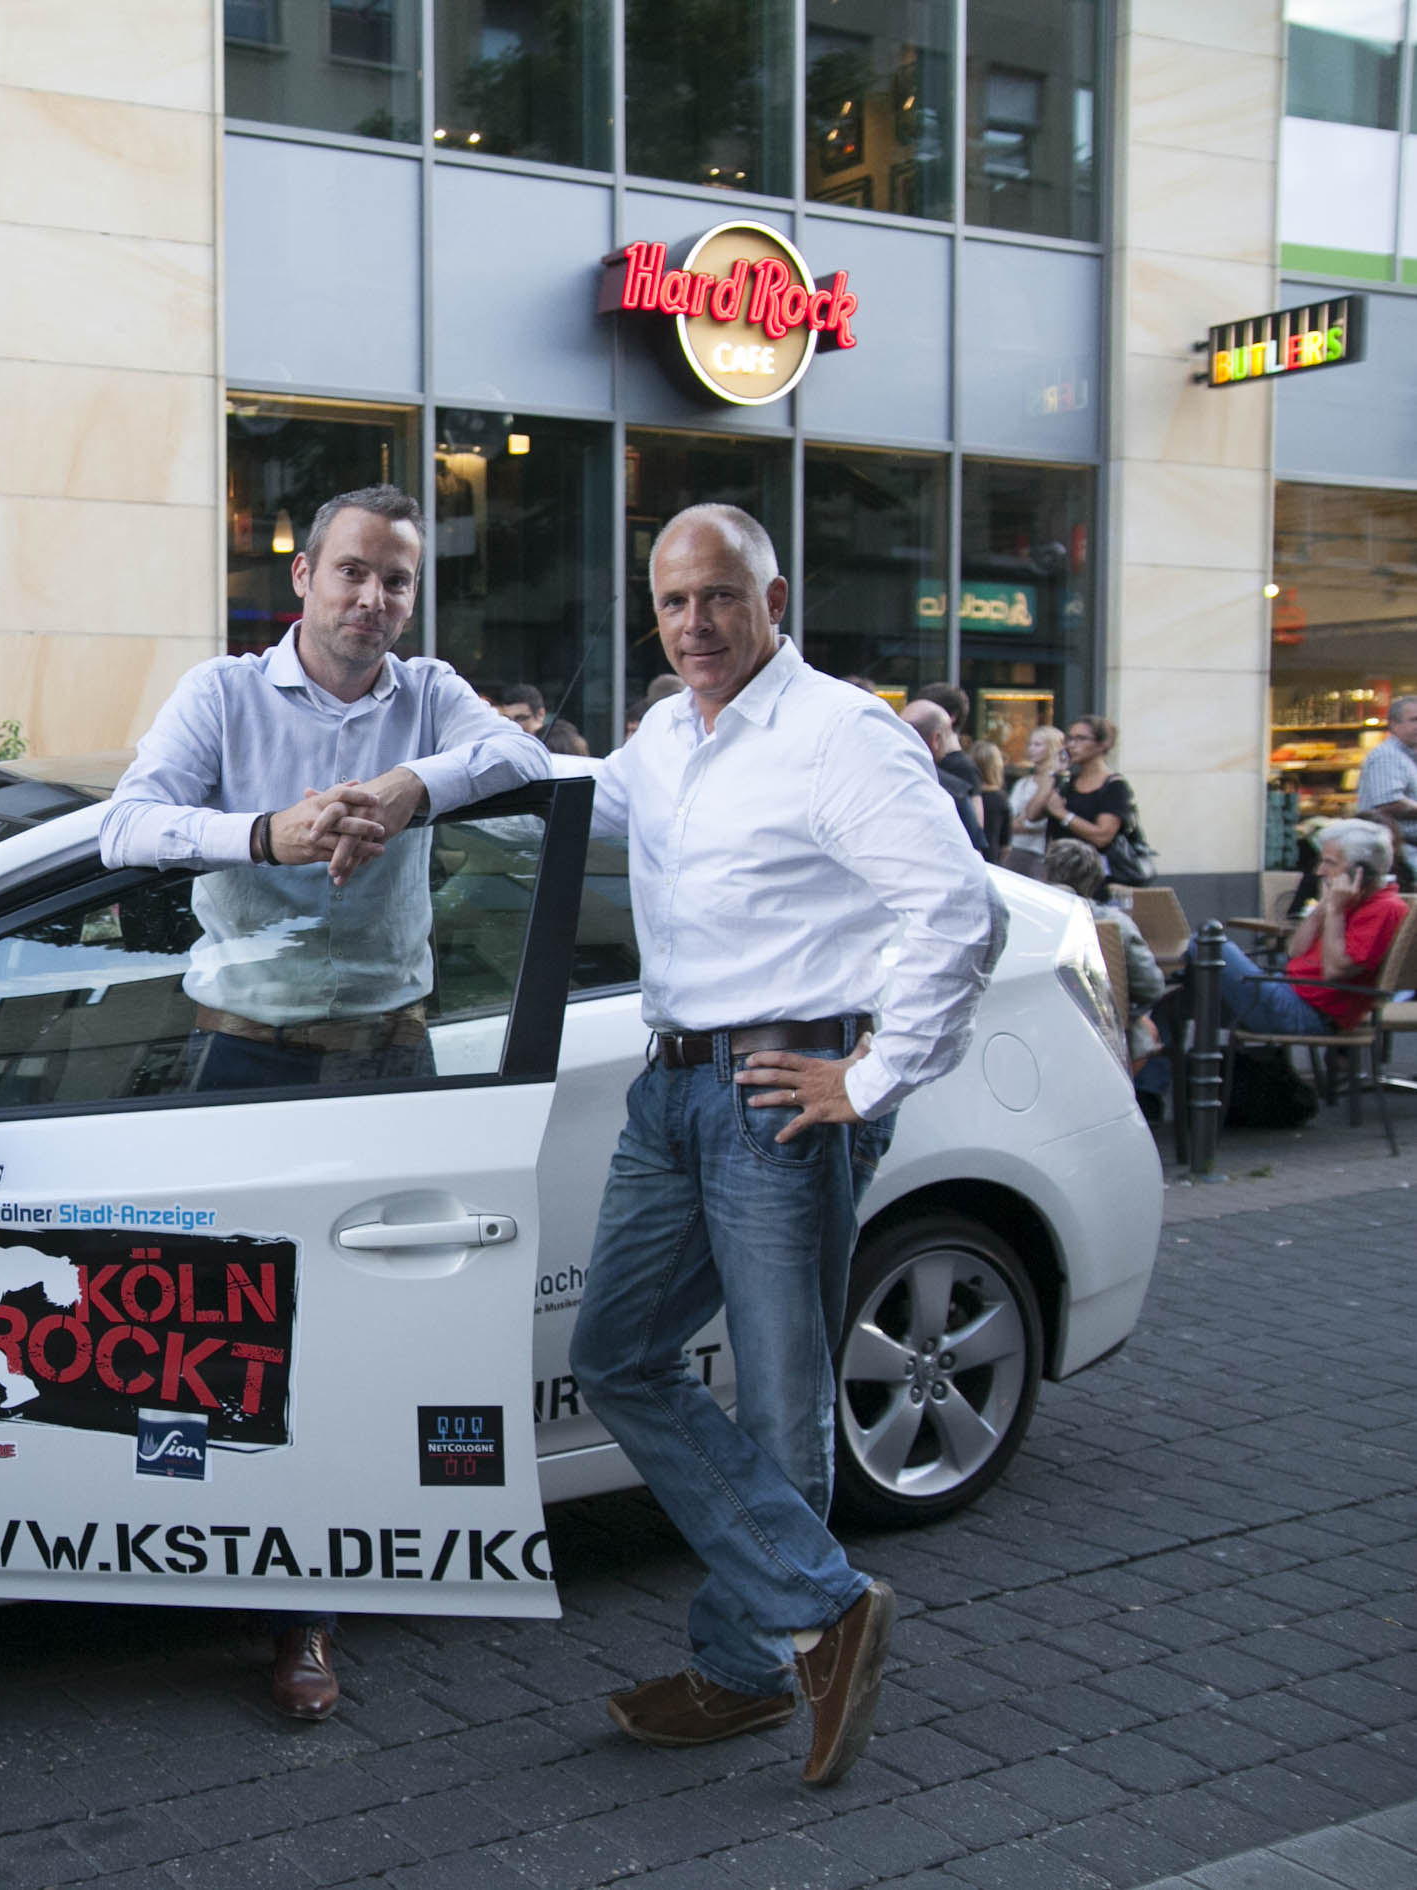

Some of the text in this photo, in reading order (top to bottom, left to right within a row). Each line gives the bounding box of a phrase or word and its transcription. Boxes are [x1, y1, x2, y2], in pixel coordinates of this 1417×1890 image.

[622, 241, 858, 349] Hard Rock
[712, 341, 775, 375] CAFE
[1214, 326, 1344, 385] BUTLERS
[59, 1203, 216, 1231] Stadt-Anzeiger
[75, 1247, 277, 1323] KÖLN
[138, 1430, 204, 1461] Sion
